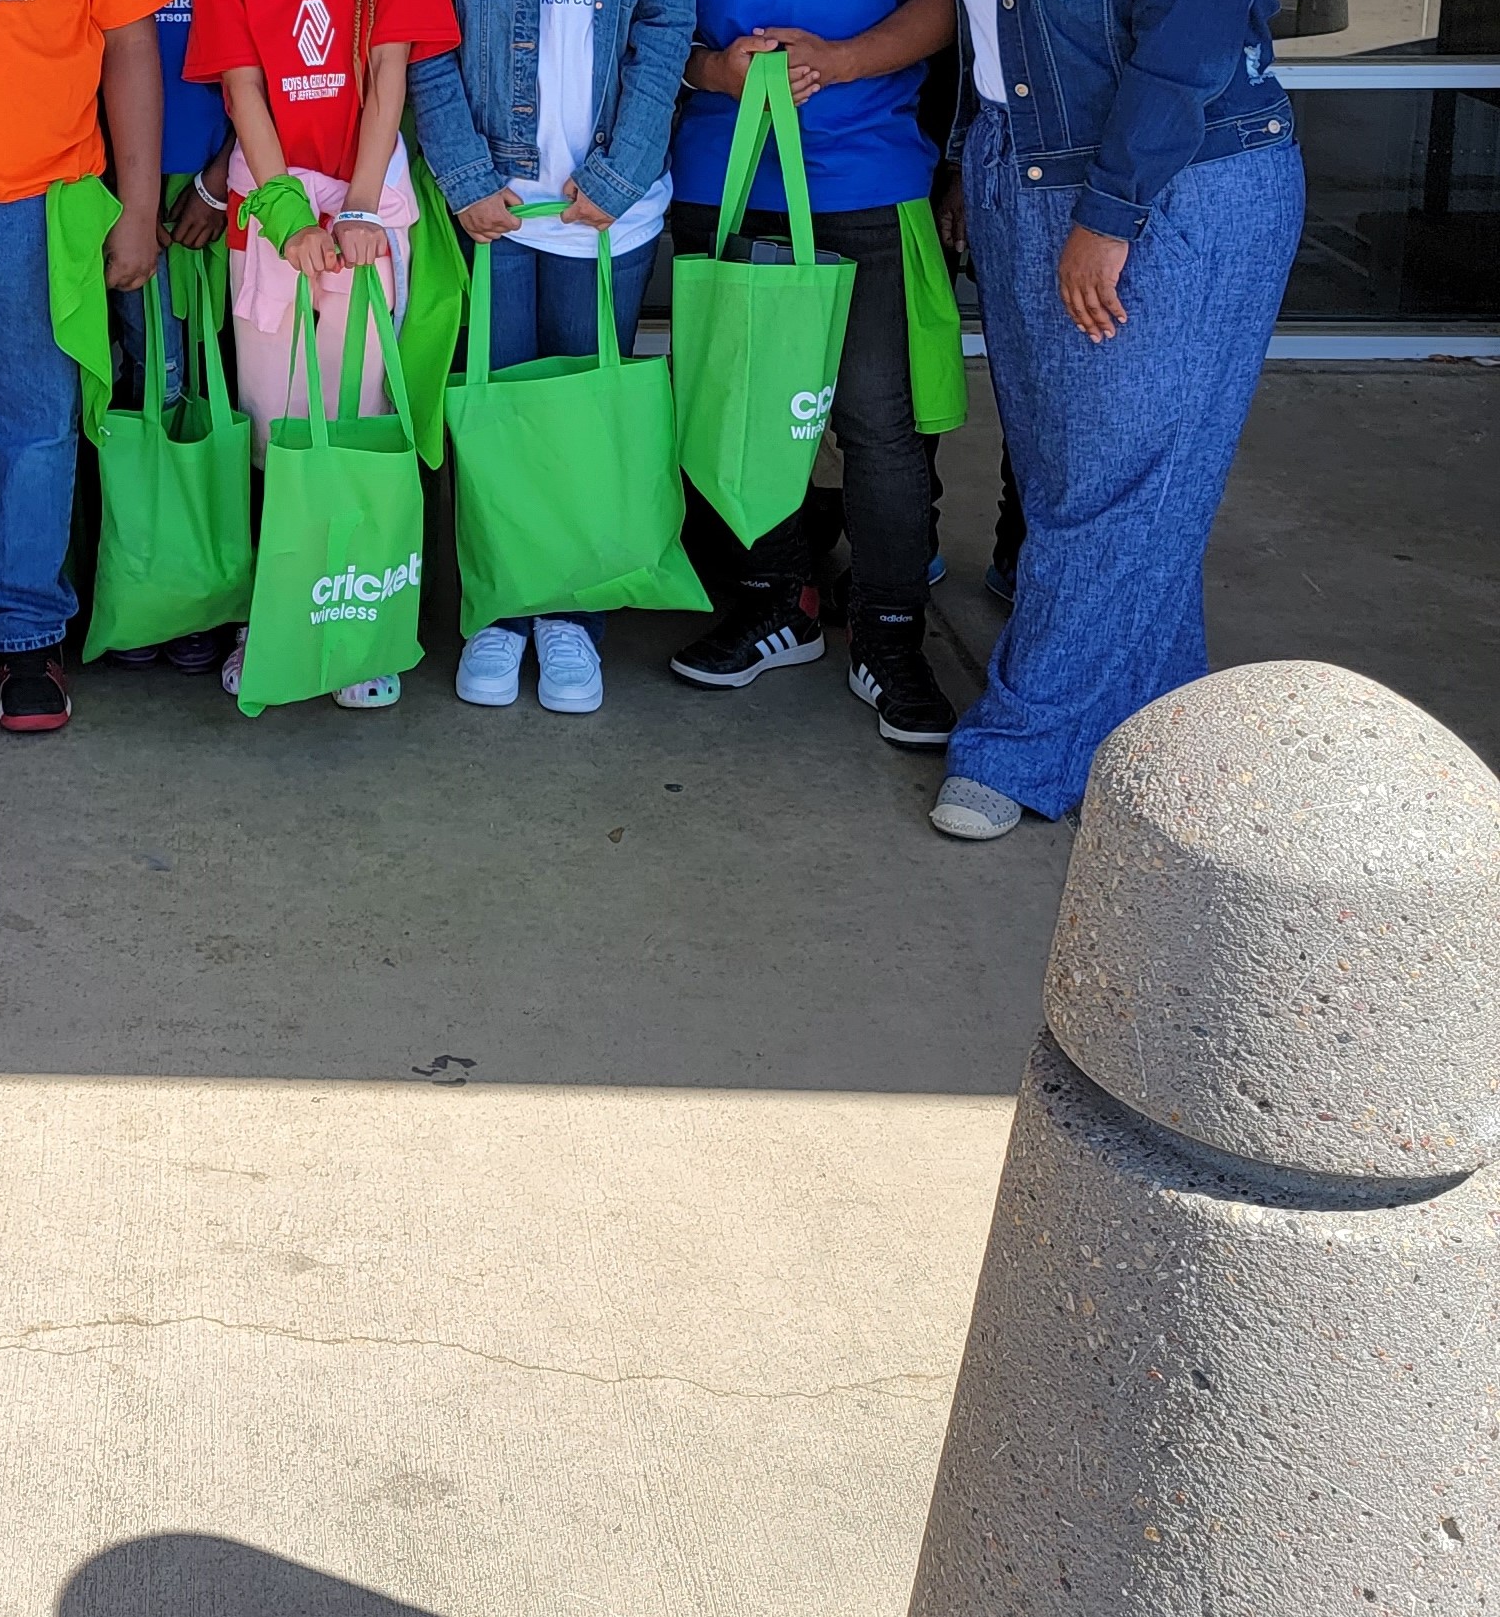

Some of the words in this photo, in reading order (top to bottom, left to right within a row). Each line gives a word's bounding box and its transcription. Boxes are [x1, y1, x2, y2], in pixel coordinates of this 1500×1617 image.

[281, 77, 302, 92] BOYS
[302, 75, 311, 90] &
[310, 73, 327, 89] GIRLS
[326, 73, 346, 87] CLUB
[311, 551, 422, 605] cricket
[310, 602, 378, 625] wireless
[879, 613, 913, 623] adidas
